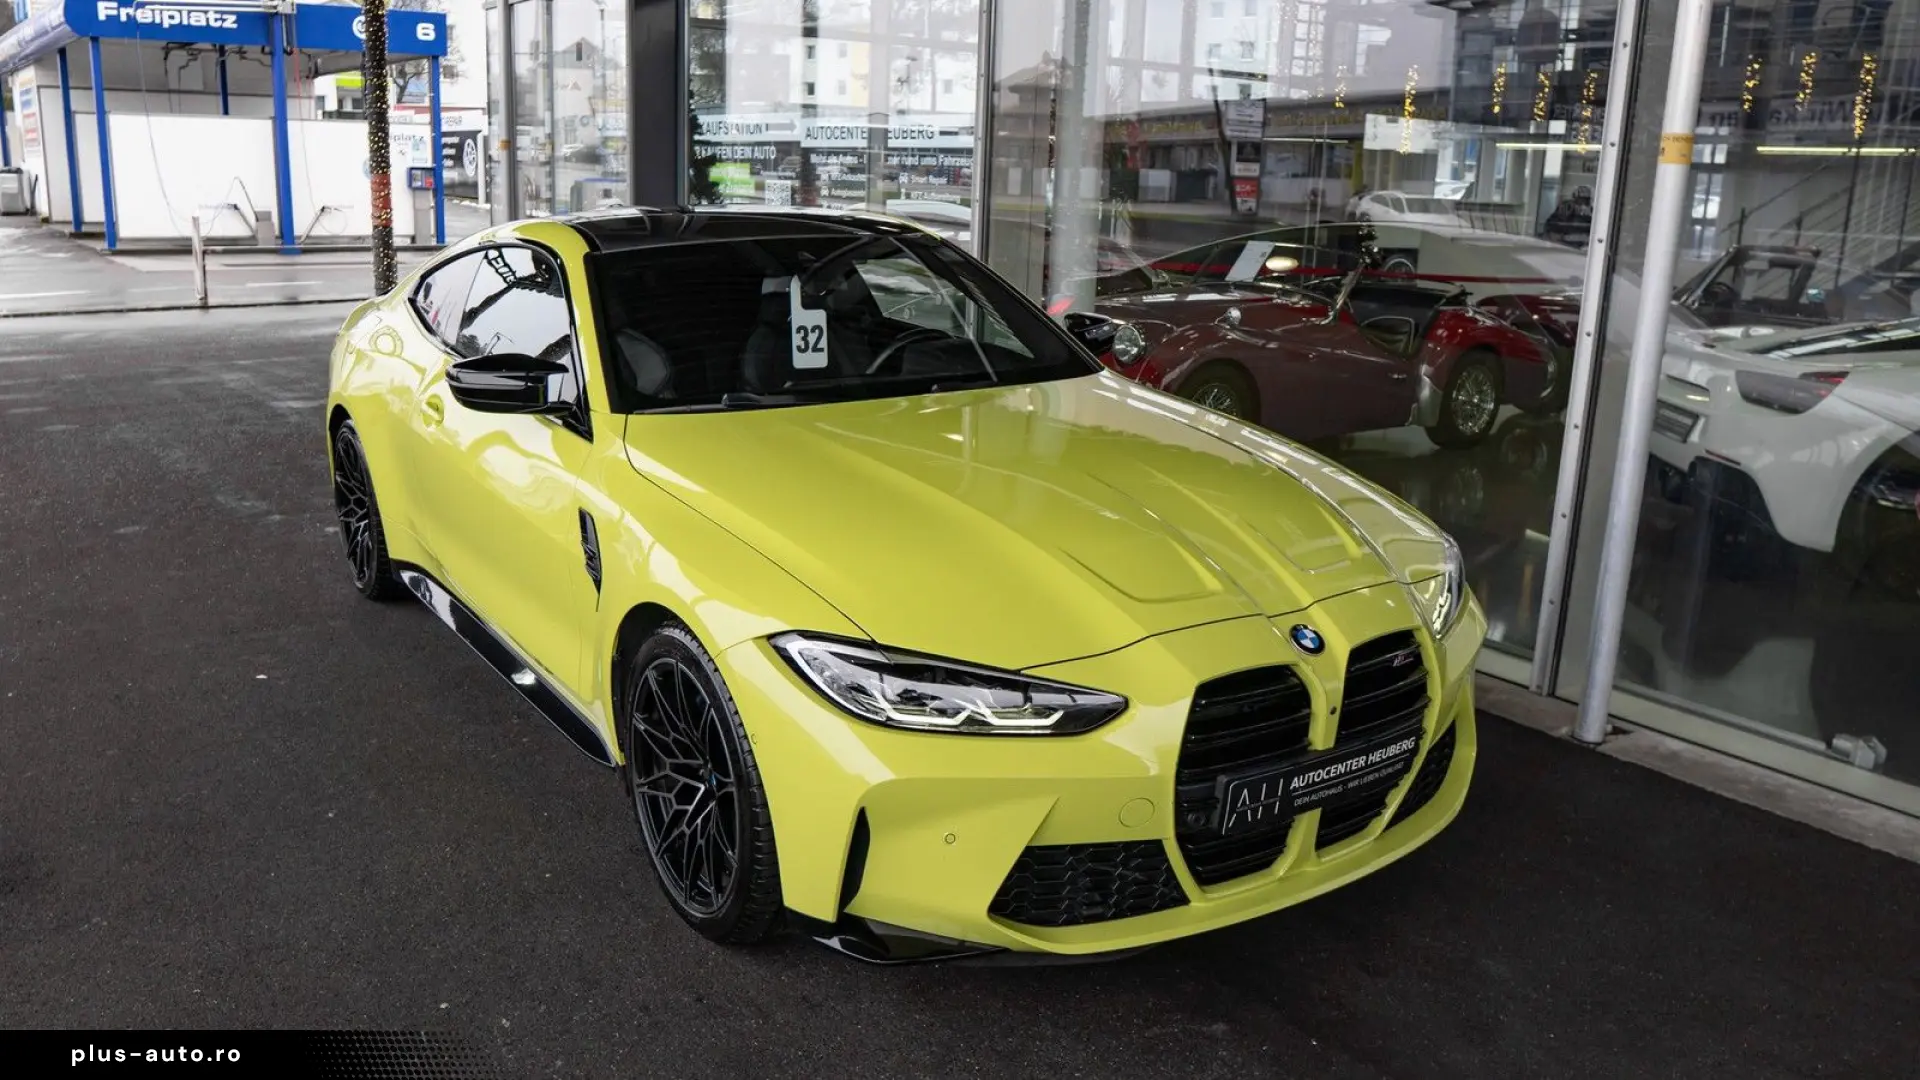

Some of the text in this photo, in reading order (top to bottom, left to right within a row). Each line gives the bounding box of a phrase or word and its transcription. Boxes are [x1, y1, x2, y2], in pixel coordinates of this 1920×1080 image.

[97, 1, 238, 28] Freiplatz
[416, 23, 435, 40] 6
[805, 124, 934, 140] AUTOCENTE EUBERG
[795, 324, 825, 354] 32
[1289, 736, 1416, 791] AUTOCENTER HEUBERG
[1294, 795, 1310, 807] DEIN
[1309, 784, 1344, 801] AUTOHAUS
